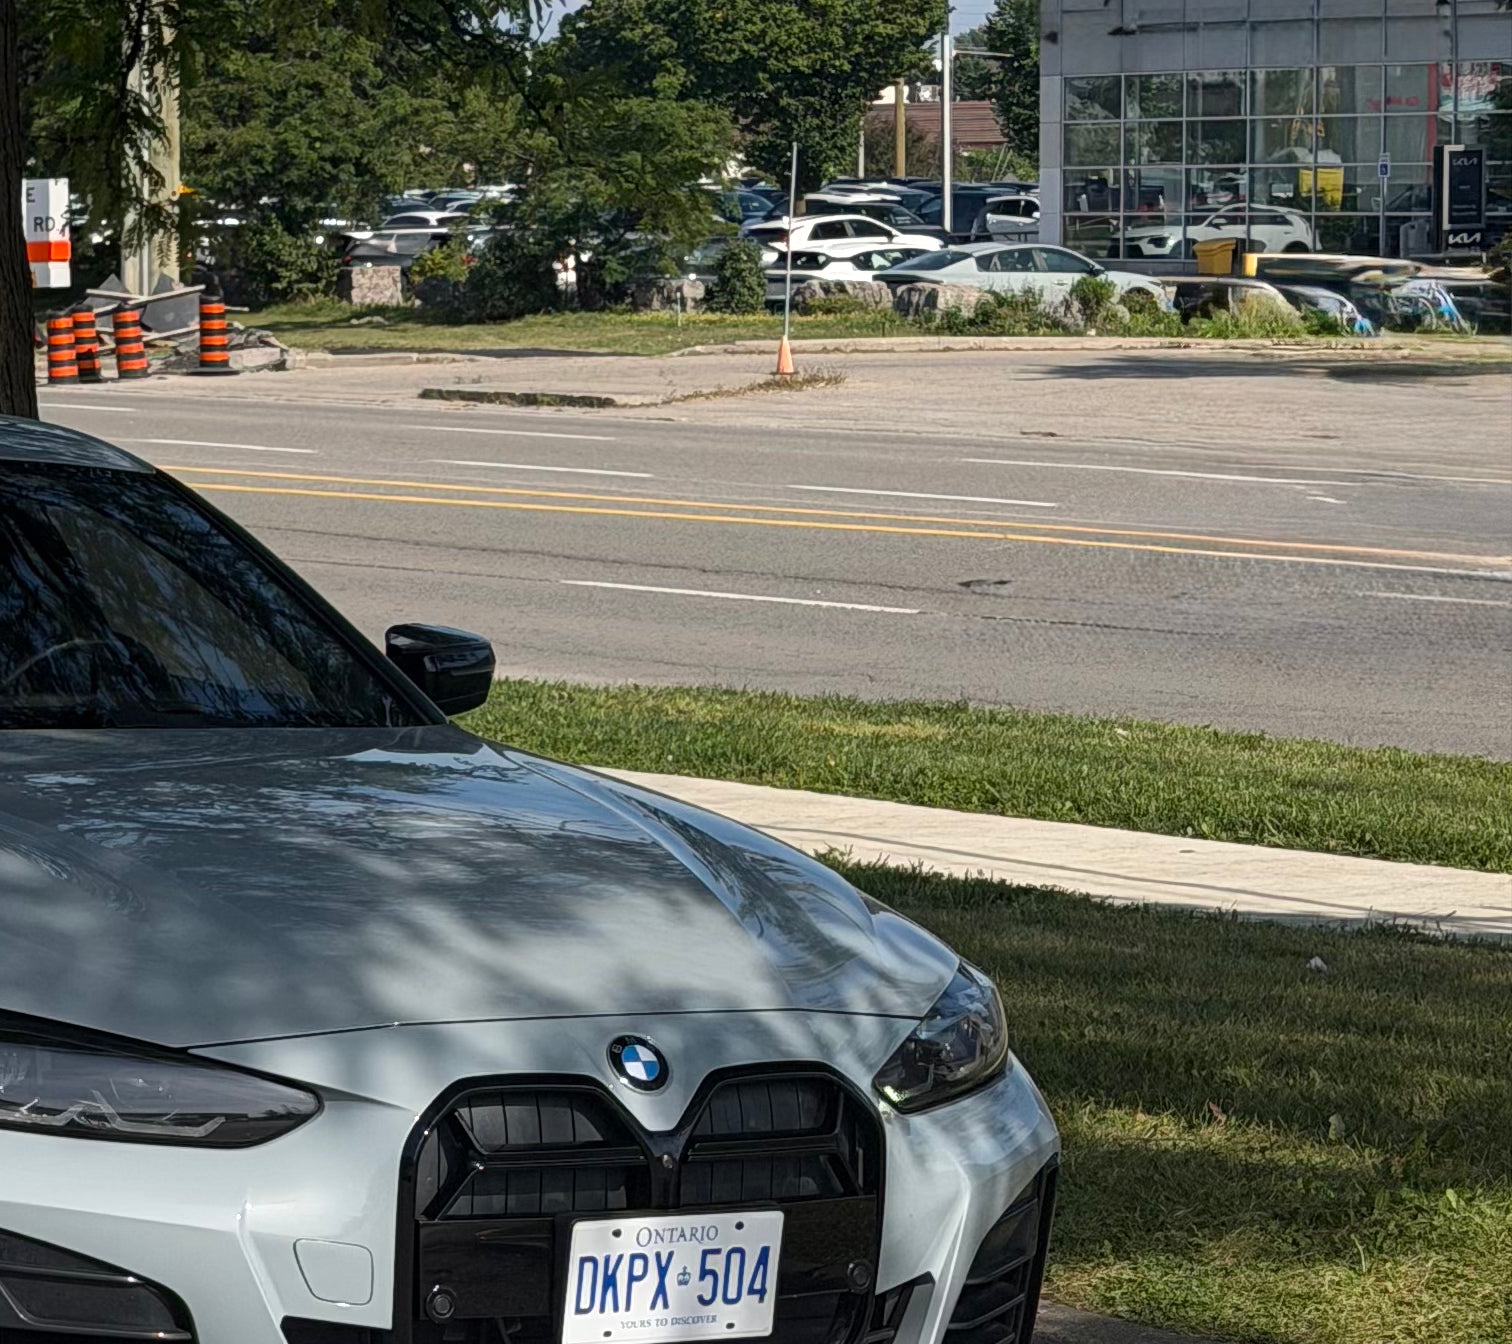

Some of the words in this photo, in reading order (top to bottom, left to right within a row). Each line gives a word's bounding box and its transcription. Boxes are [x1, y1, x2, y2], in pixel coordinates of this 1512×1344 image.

[574, 1250, 675, 1315] DKPX
[696, 1245, 771, 1306] 504
[620, 1318, 652, 1330] YOURS
[655, 1317, 669, 1327] TO
[670, 1314, 718, 1326] DISCOVER
